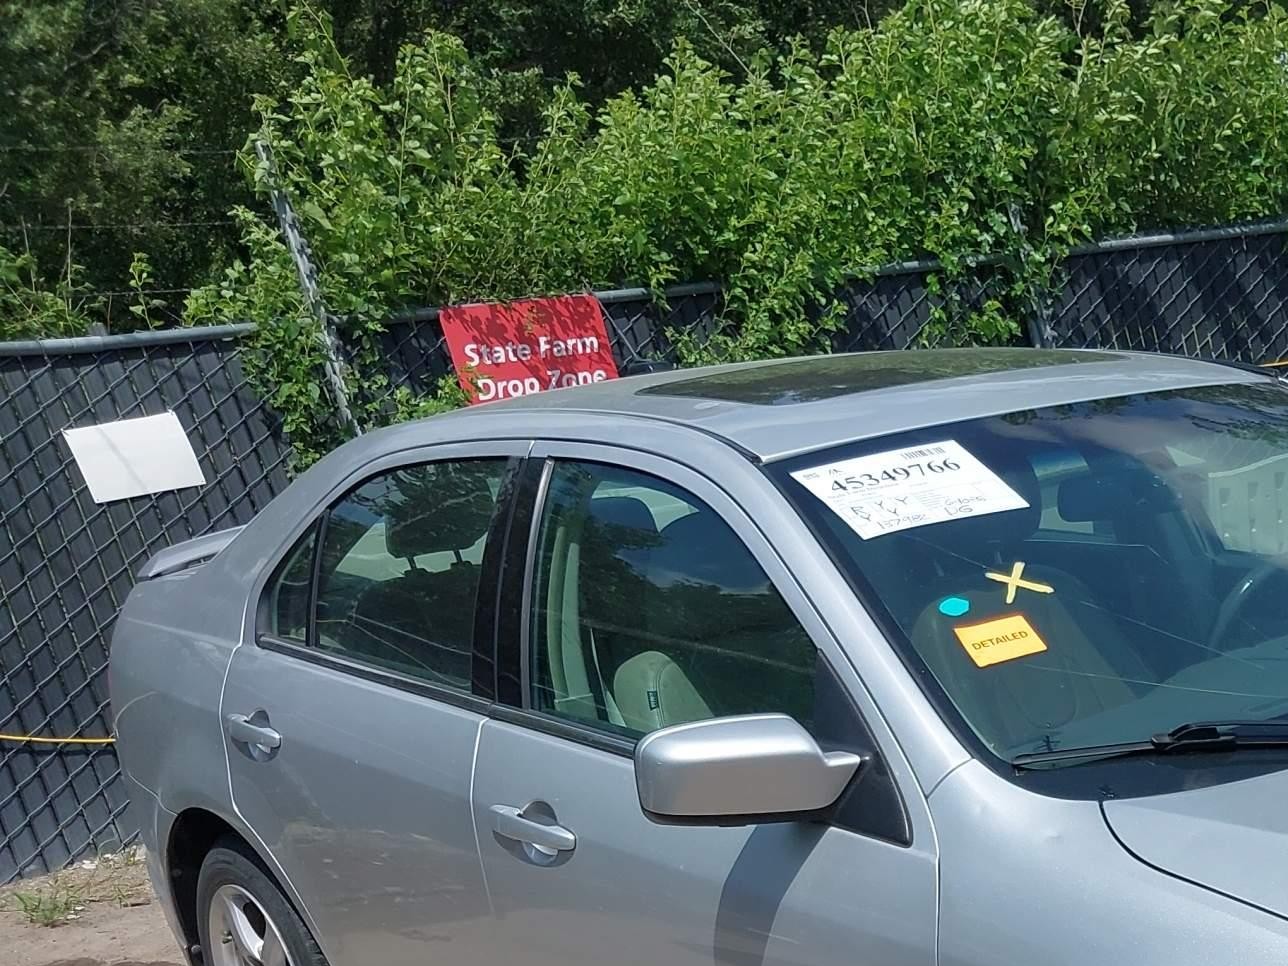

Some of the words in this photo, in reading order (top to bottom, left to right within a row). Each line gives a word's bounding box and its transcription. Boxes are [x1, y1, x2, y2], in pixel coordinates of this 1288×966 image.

[464, 341, 531, 367] State
[538, 335, 599, 358] Farm
[831, 458, 960, 492] 45349766
[971, 631, 1029, 650] DETAILED
